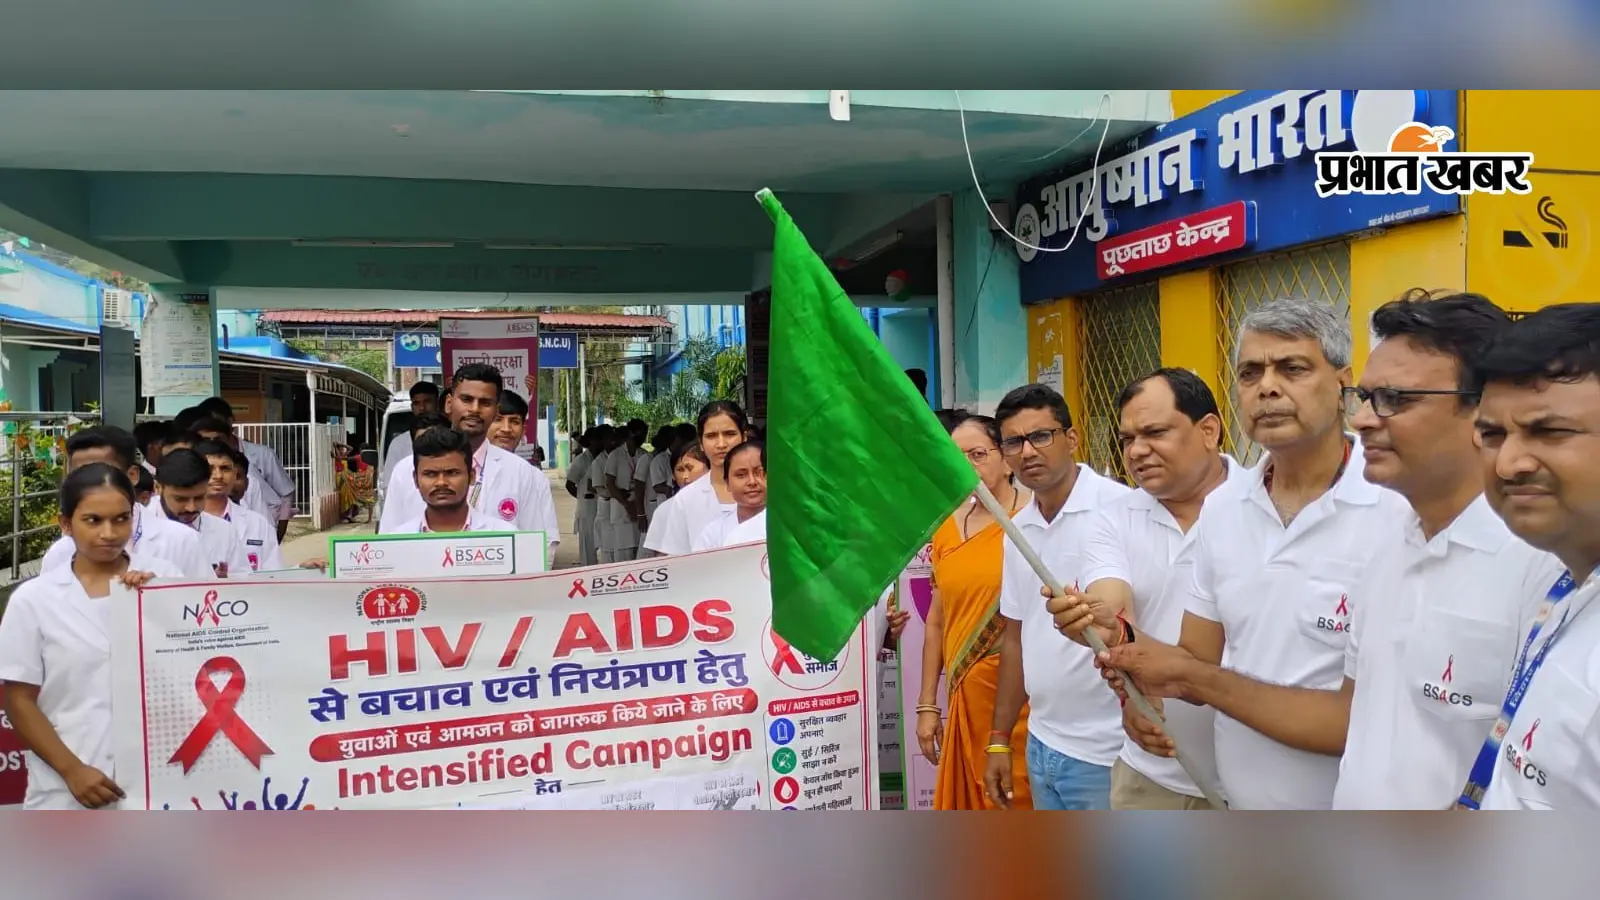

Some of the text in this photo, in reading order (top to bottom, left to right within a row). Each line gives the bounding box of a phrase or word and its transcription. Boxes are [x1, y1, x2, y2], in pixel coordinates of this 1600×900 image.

[1041, 90, 1348, 242] आयुष्मान भारत
[1103, 216, 1232, 276] पूछताछ केन्द्र
[538, 337, 571, 351] S.N.C.U)
[493, 355, 523, 373] सुरक्षा
[455, 547, 504, 562] BSACS
[592, 568, 669, 589] BSACS
[183, 589, 249, 628] NACO
[1317, 616, 1351, 633] BSAC
[328, 599, 735, 681] HIV / AIDS
[308, 649, 749, 722] से बचाव एवं नियंत्रण हेतु
[1423, 683, 1473, 707] BSACS
[773, 703, 787, 713] HIV
[793, 700, 811, 710] AIDS
[338, 693, 744, 759] युवाओं एवं आमजन को जागरूक किये जाने के लिए
[799, 716, 824, 730] सुरक्षित
[338, 725, 752, 798] Intensified Campaign
[1506, 744, 1547, 787] BSACS
[534, 778, 562, 795] हेत
